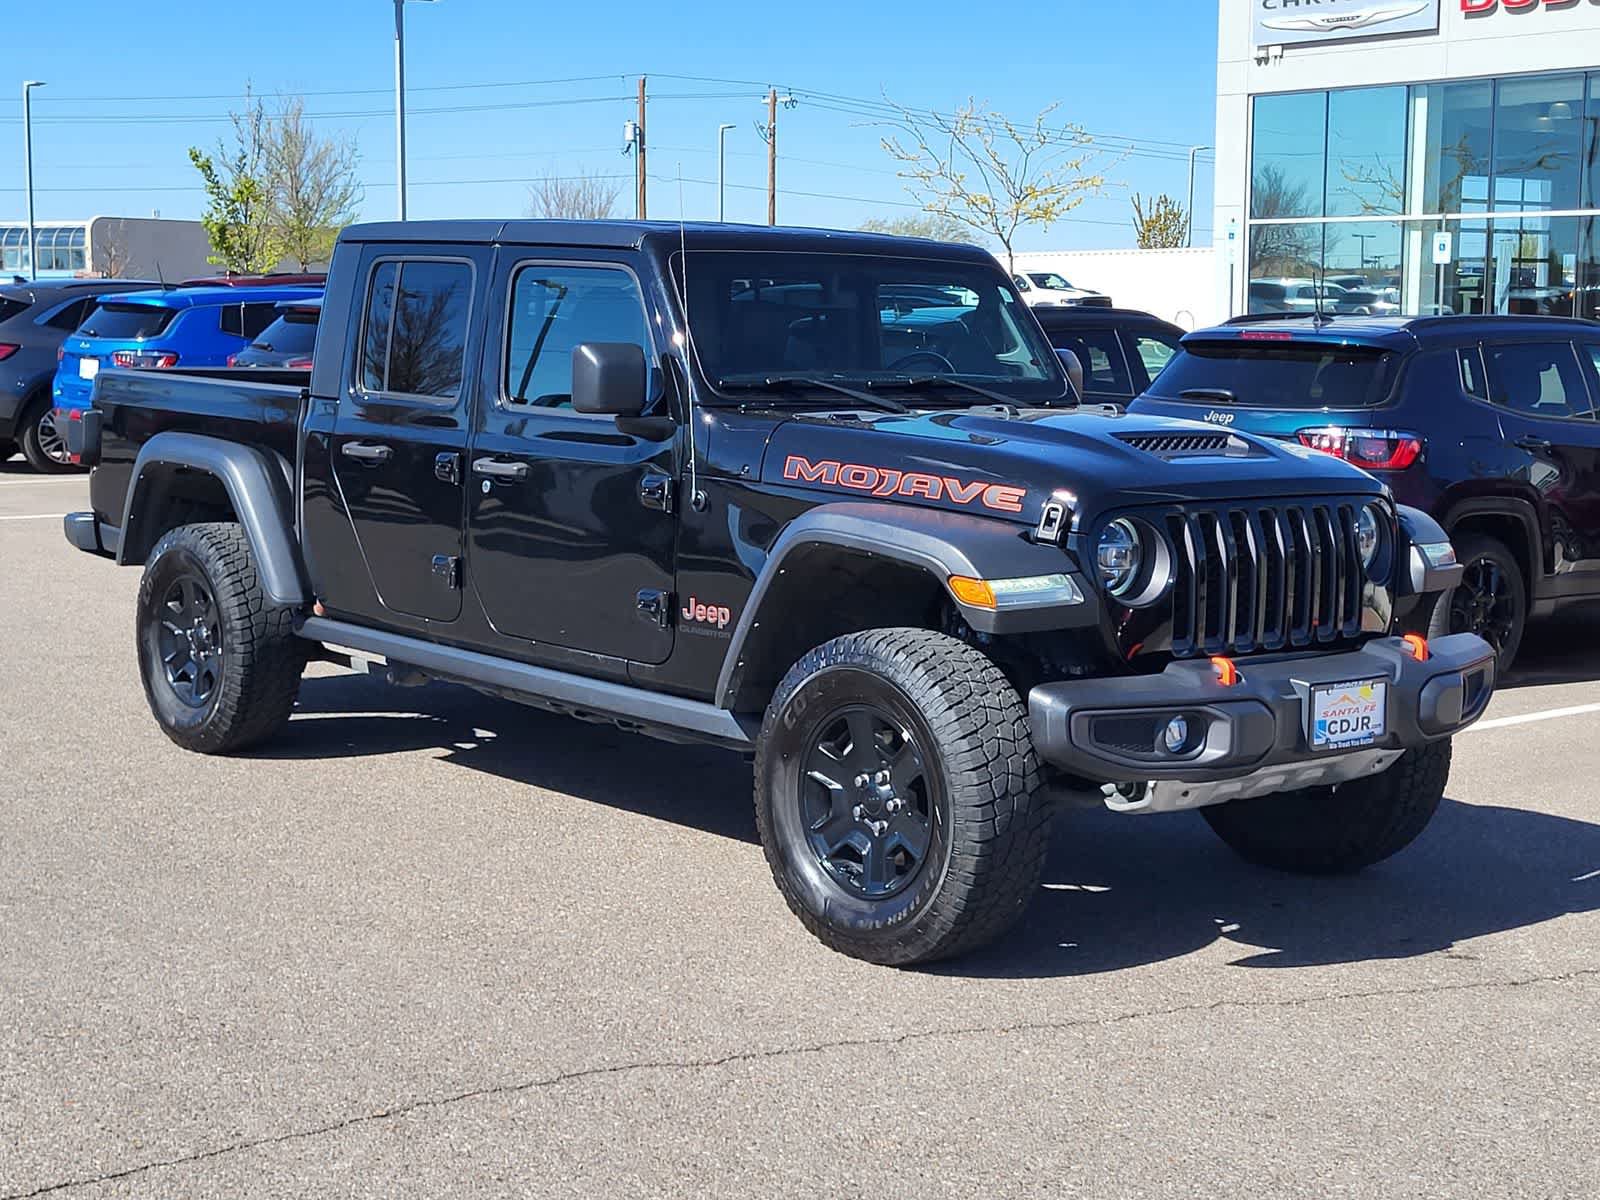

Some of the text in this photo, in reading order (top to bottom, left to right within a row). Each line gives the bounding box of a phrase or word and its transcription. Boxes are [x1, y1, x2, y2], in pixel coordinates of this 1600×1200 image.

[1203, 410, 1234, 425] Jeep
[784, 455, 1026, 512] MOJAVE
[682, 597, 730, 629] Jeep
[1322, 704, 1376, 718] SANTA FE
[1328, 716, 1371, 735] CDJR
